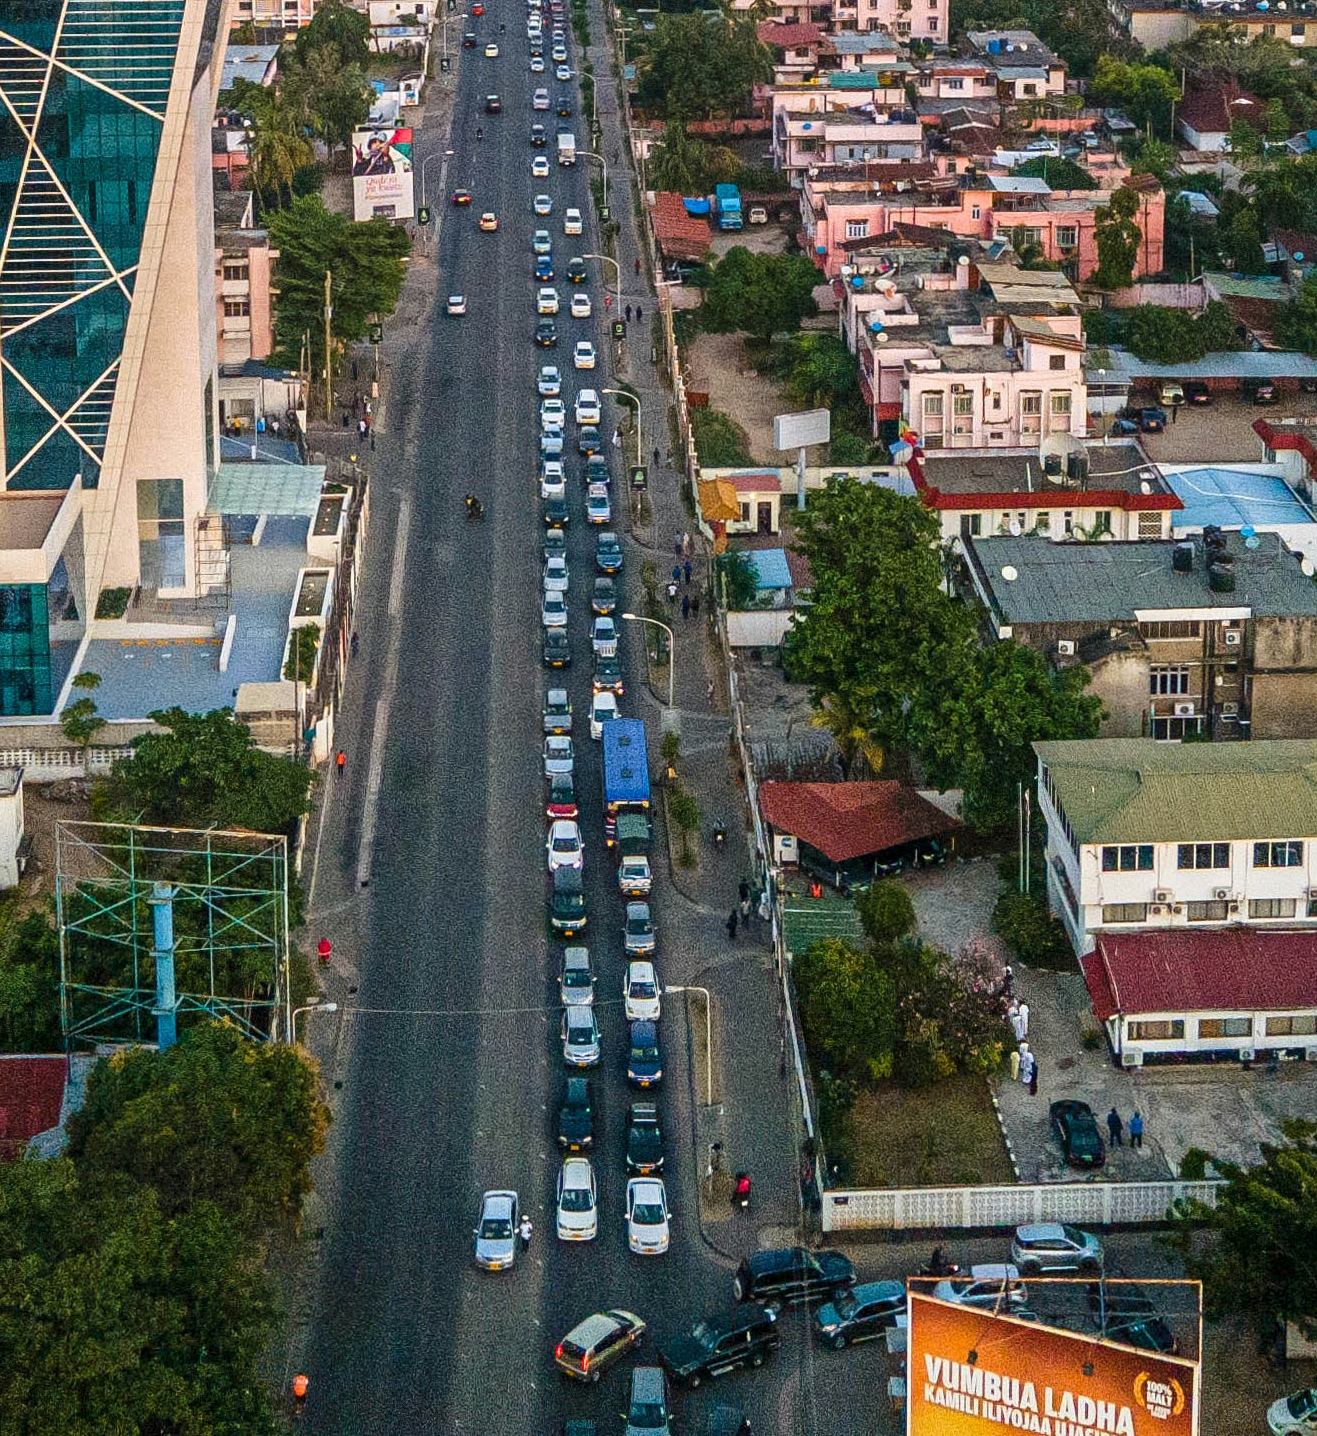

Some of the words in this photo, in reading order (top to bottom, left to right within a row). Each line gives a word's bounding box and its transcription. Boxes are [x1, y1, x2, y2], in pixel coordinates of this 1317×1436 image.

[924, 1353, 1039, 1414] VUMBUA
[1044, 1386, 1136, 1436] LADHA
[924, 1382, 980, 1416] KAMILI
[982, 1400, 1052, 1436] ILIYOJAA
[1146, 1380, 1173, 1396] 100%
